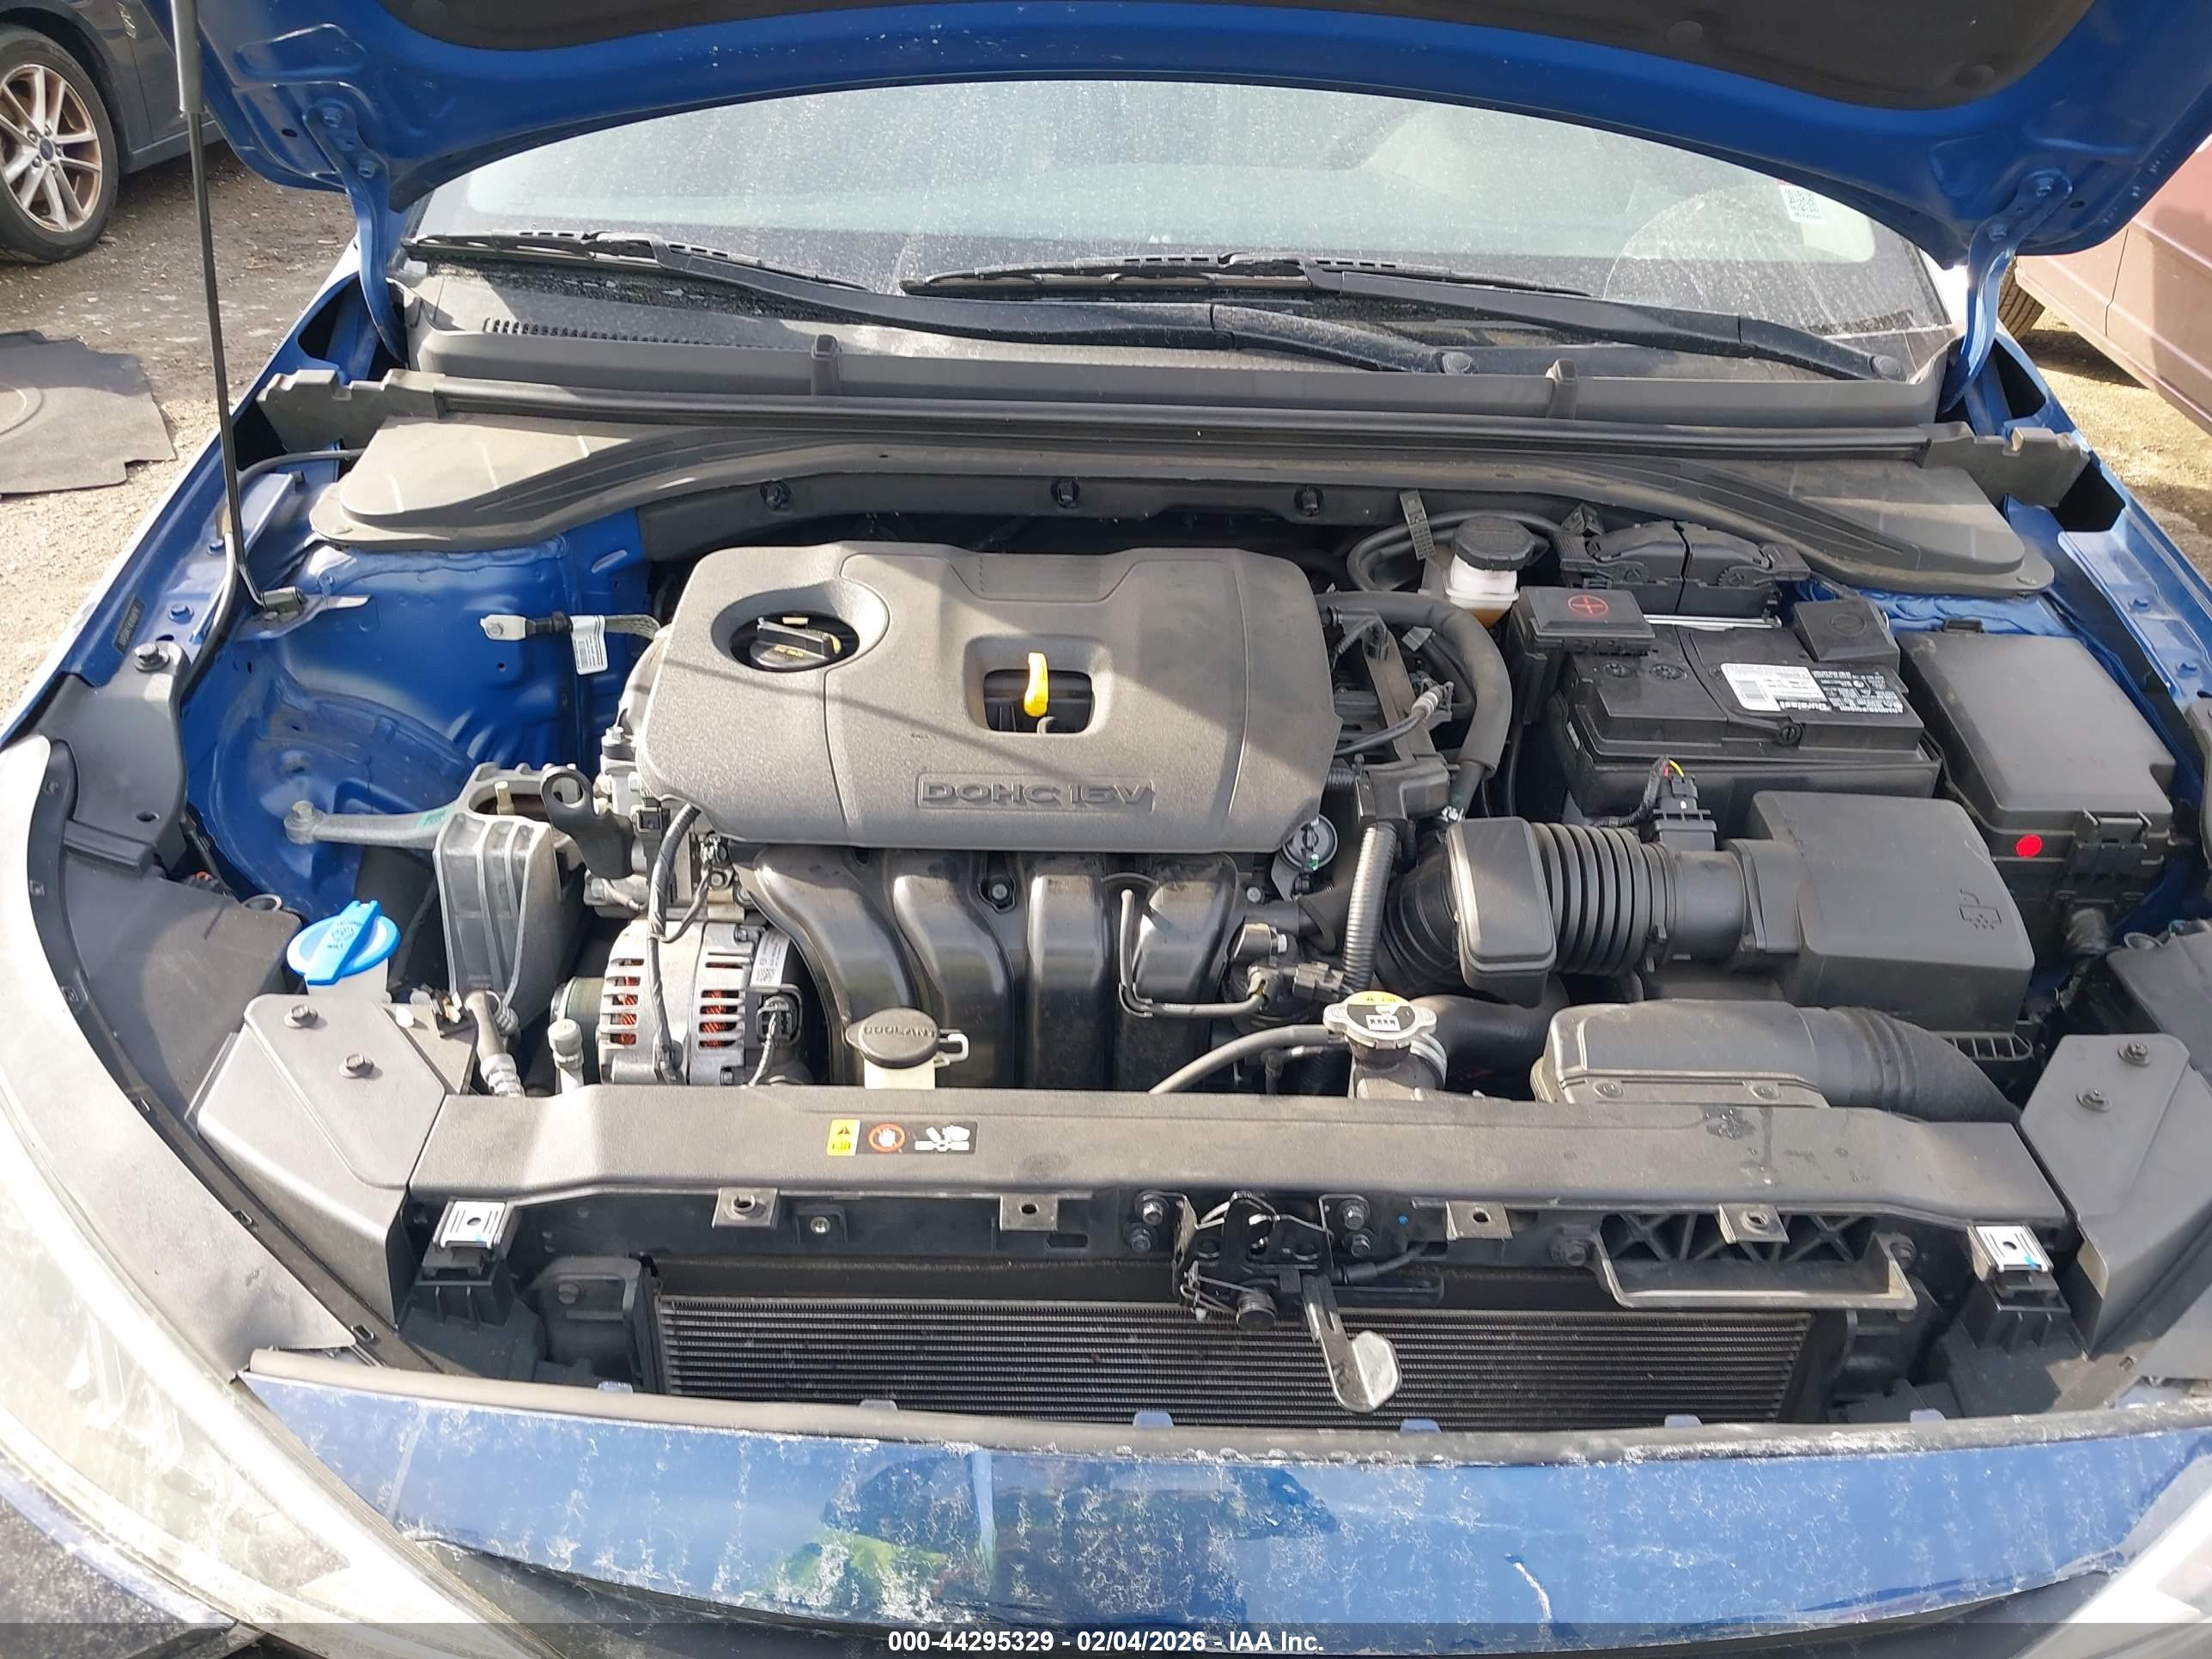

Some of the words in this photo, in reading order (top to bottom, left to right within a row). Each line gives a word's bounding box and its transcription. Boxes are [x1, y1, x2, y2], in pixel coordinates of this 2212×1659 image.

[921, 782, 1061, 805] DOHC
[1067, 782, 1148, 805] 16V
[864, 1024, 935, 1038] COOLANT
